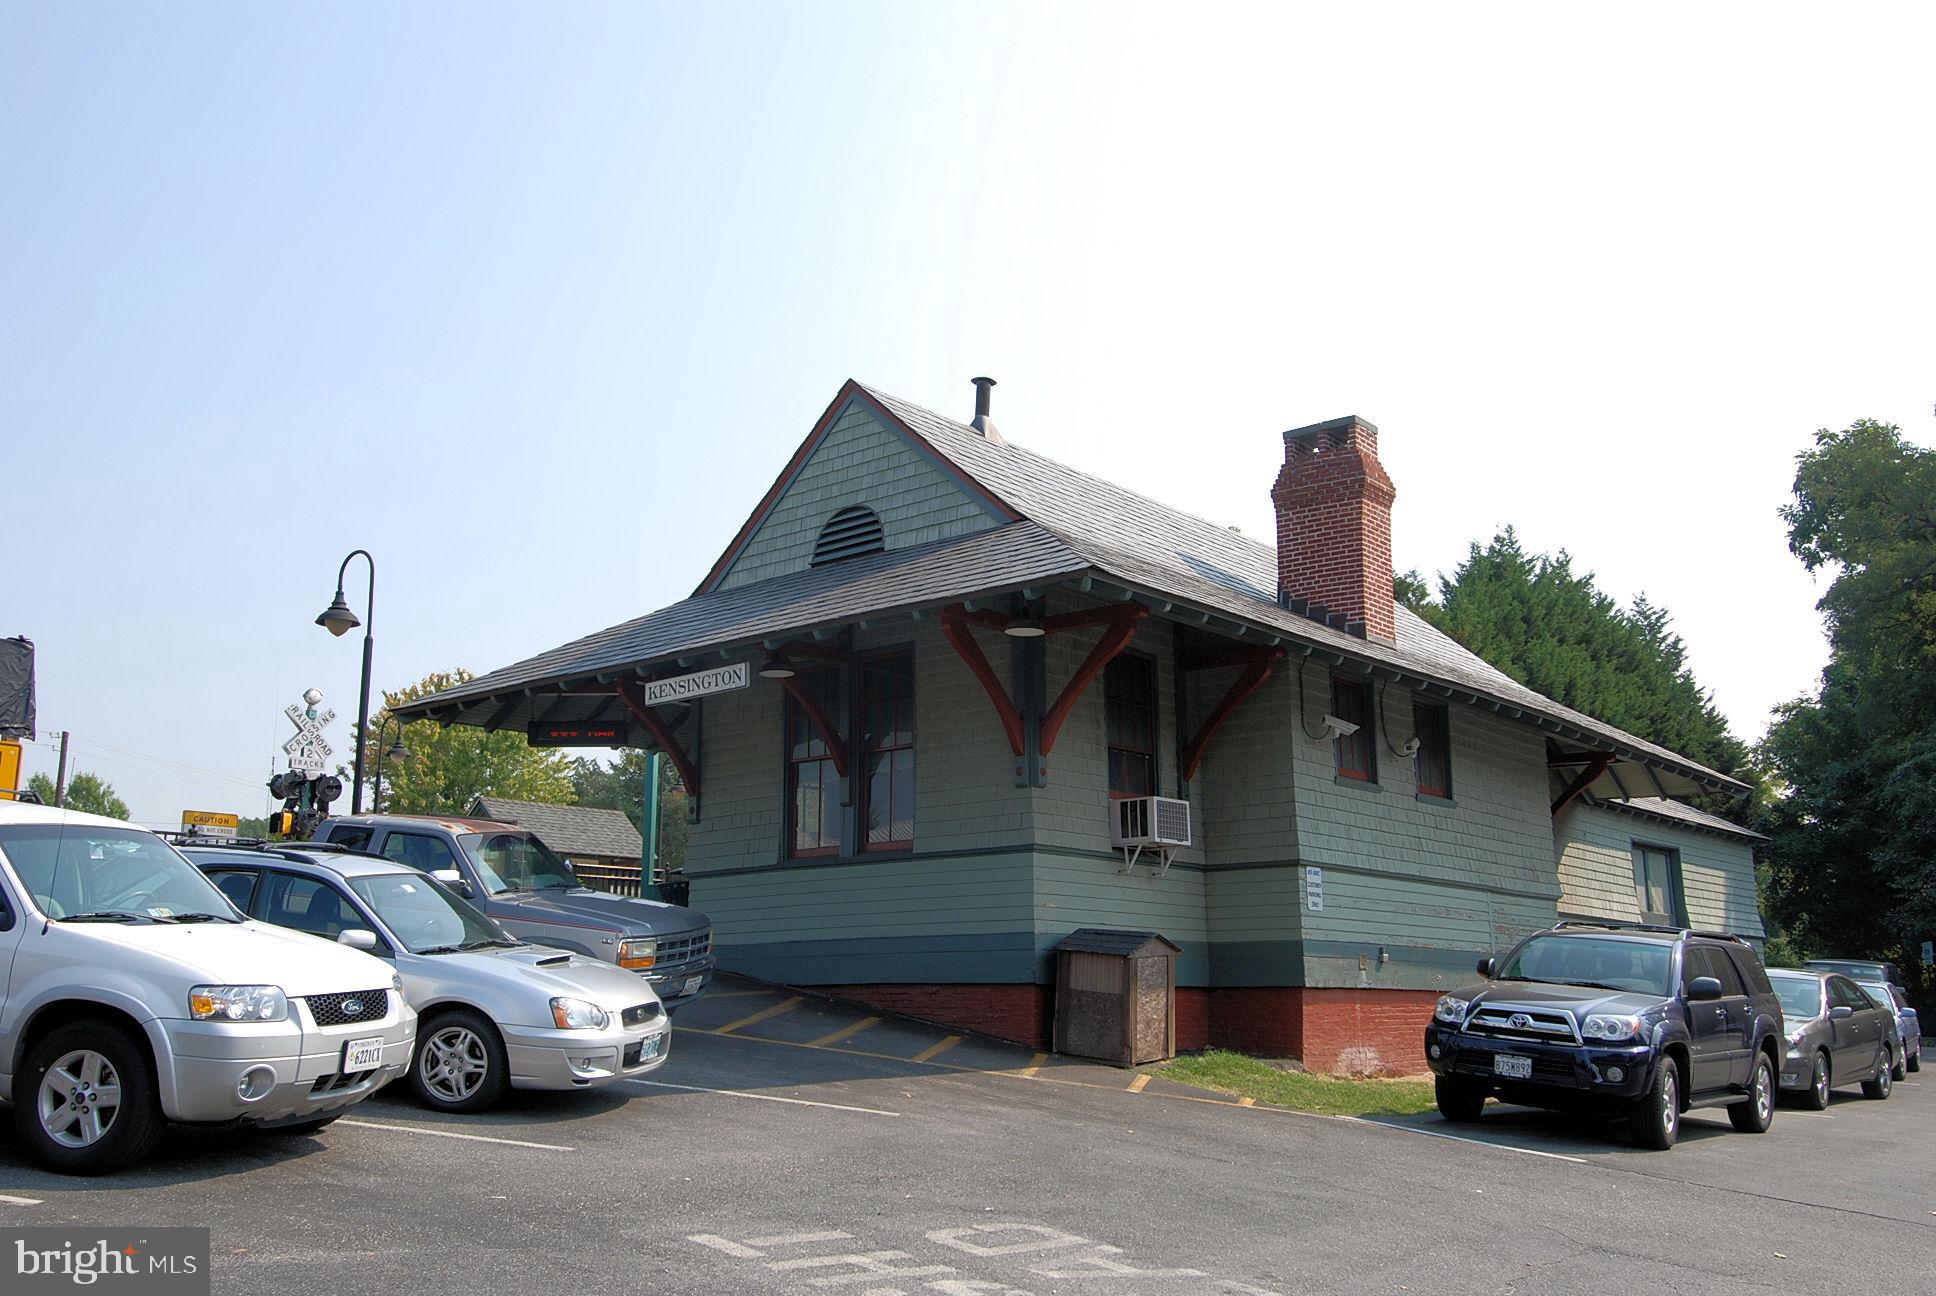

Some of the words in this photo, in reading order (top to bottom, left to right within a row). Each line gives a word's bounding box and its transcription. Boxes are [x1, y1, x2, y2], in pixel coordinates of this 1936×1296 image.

[648, 667, 742, 700] KENSINGTON
[289, 710, 336, 752] CROSSING
[306, 749, 313, 759] 2
[293, 759, 325, 769] TRACKS
[193, 815, 230, 825] CAUTION
[354, 1048, 380, 1065] 6221CX
